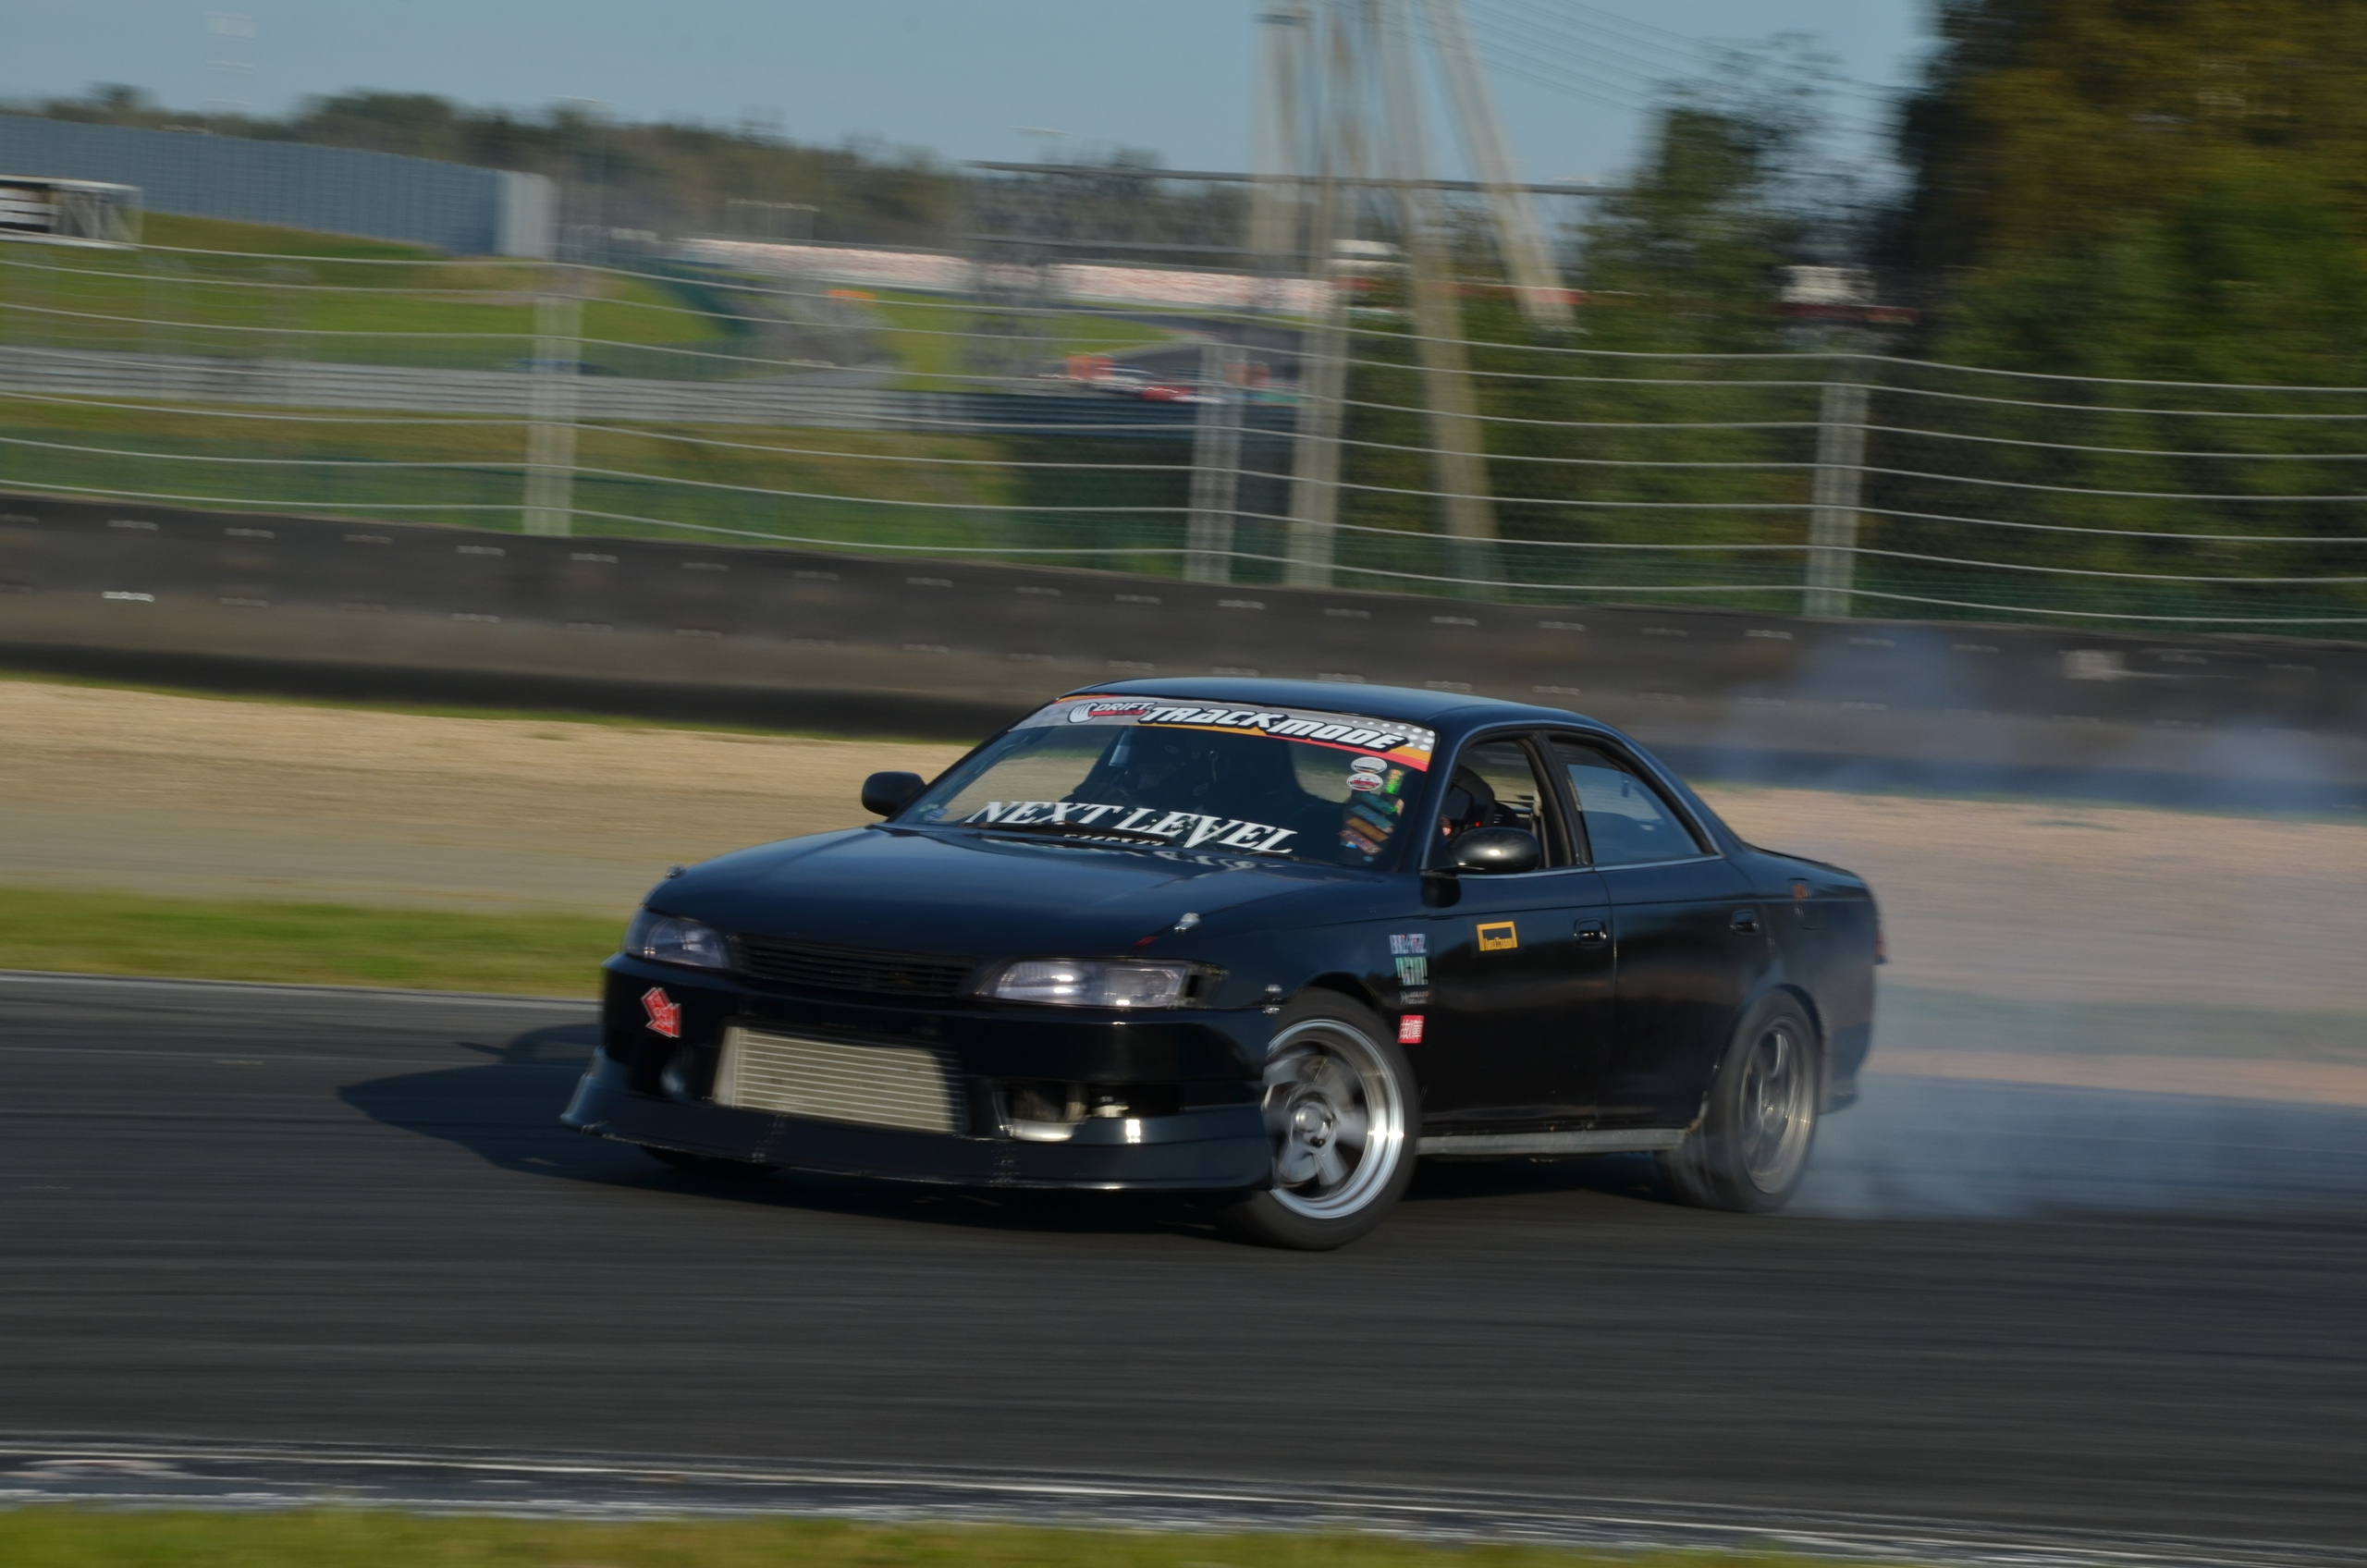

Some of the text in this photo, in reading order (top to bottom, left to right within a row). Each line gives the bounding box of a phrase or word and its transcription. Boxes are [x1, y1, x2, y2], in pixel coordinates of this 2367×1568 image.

[1093, 703, 1157, 711] DRIFT
[965, 802, 1123, 825] NEXT
[1112, 808, 1298, 853] LEVEL
